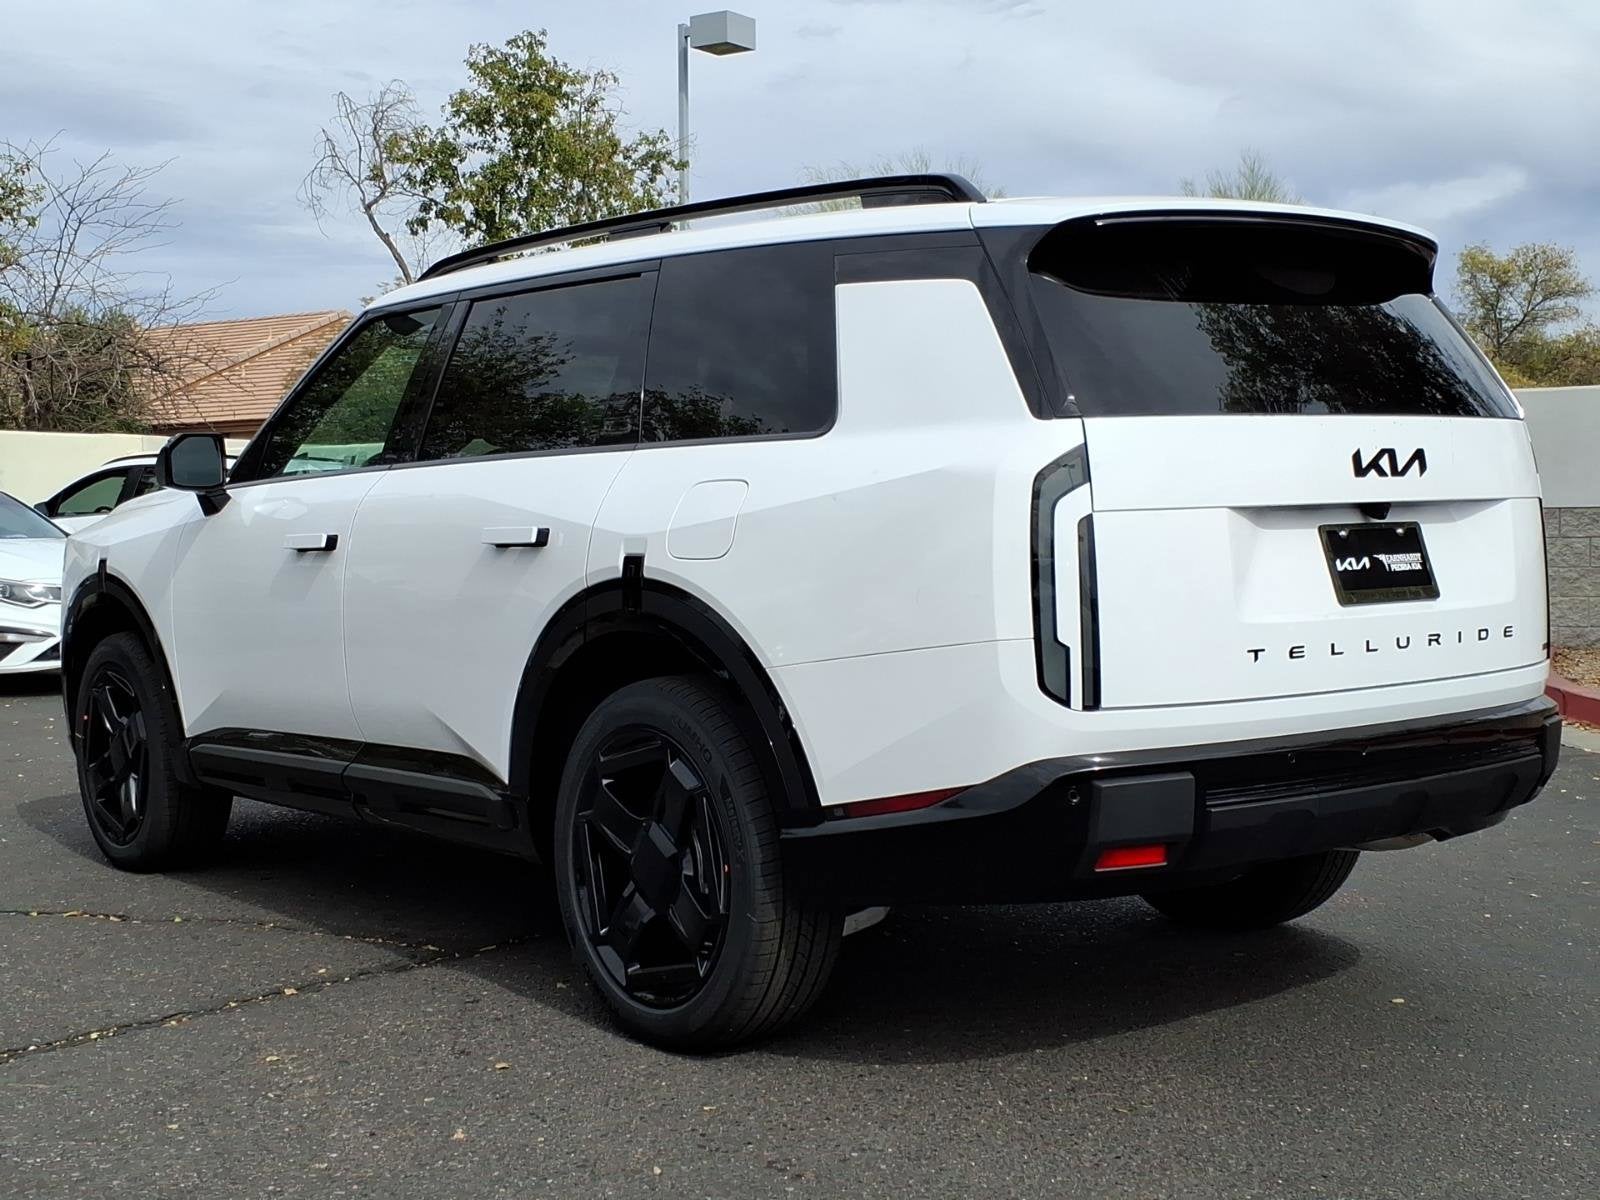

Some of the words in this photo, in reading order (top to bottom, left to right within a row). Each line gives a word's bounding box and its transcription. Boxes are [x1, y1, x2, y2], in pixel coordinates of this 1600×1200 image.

[1351, 447, 1427, 478] KIA
[1336, 556, 1370, 571] KIA
[1247, 625, 1513, 663] TELLURIDE
